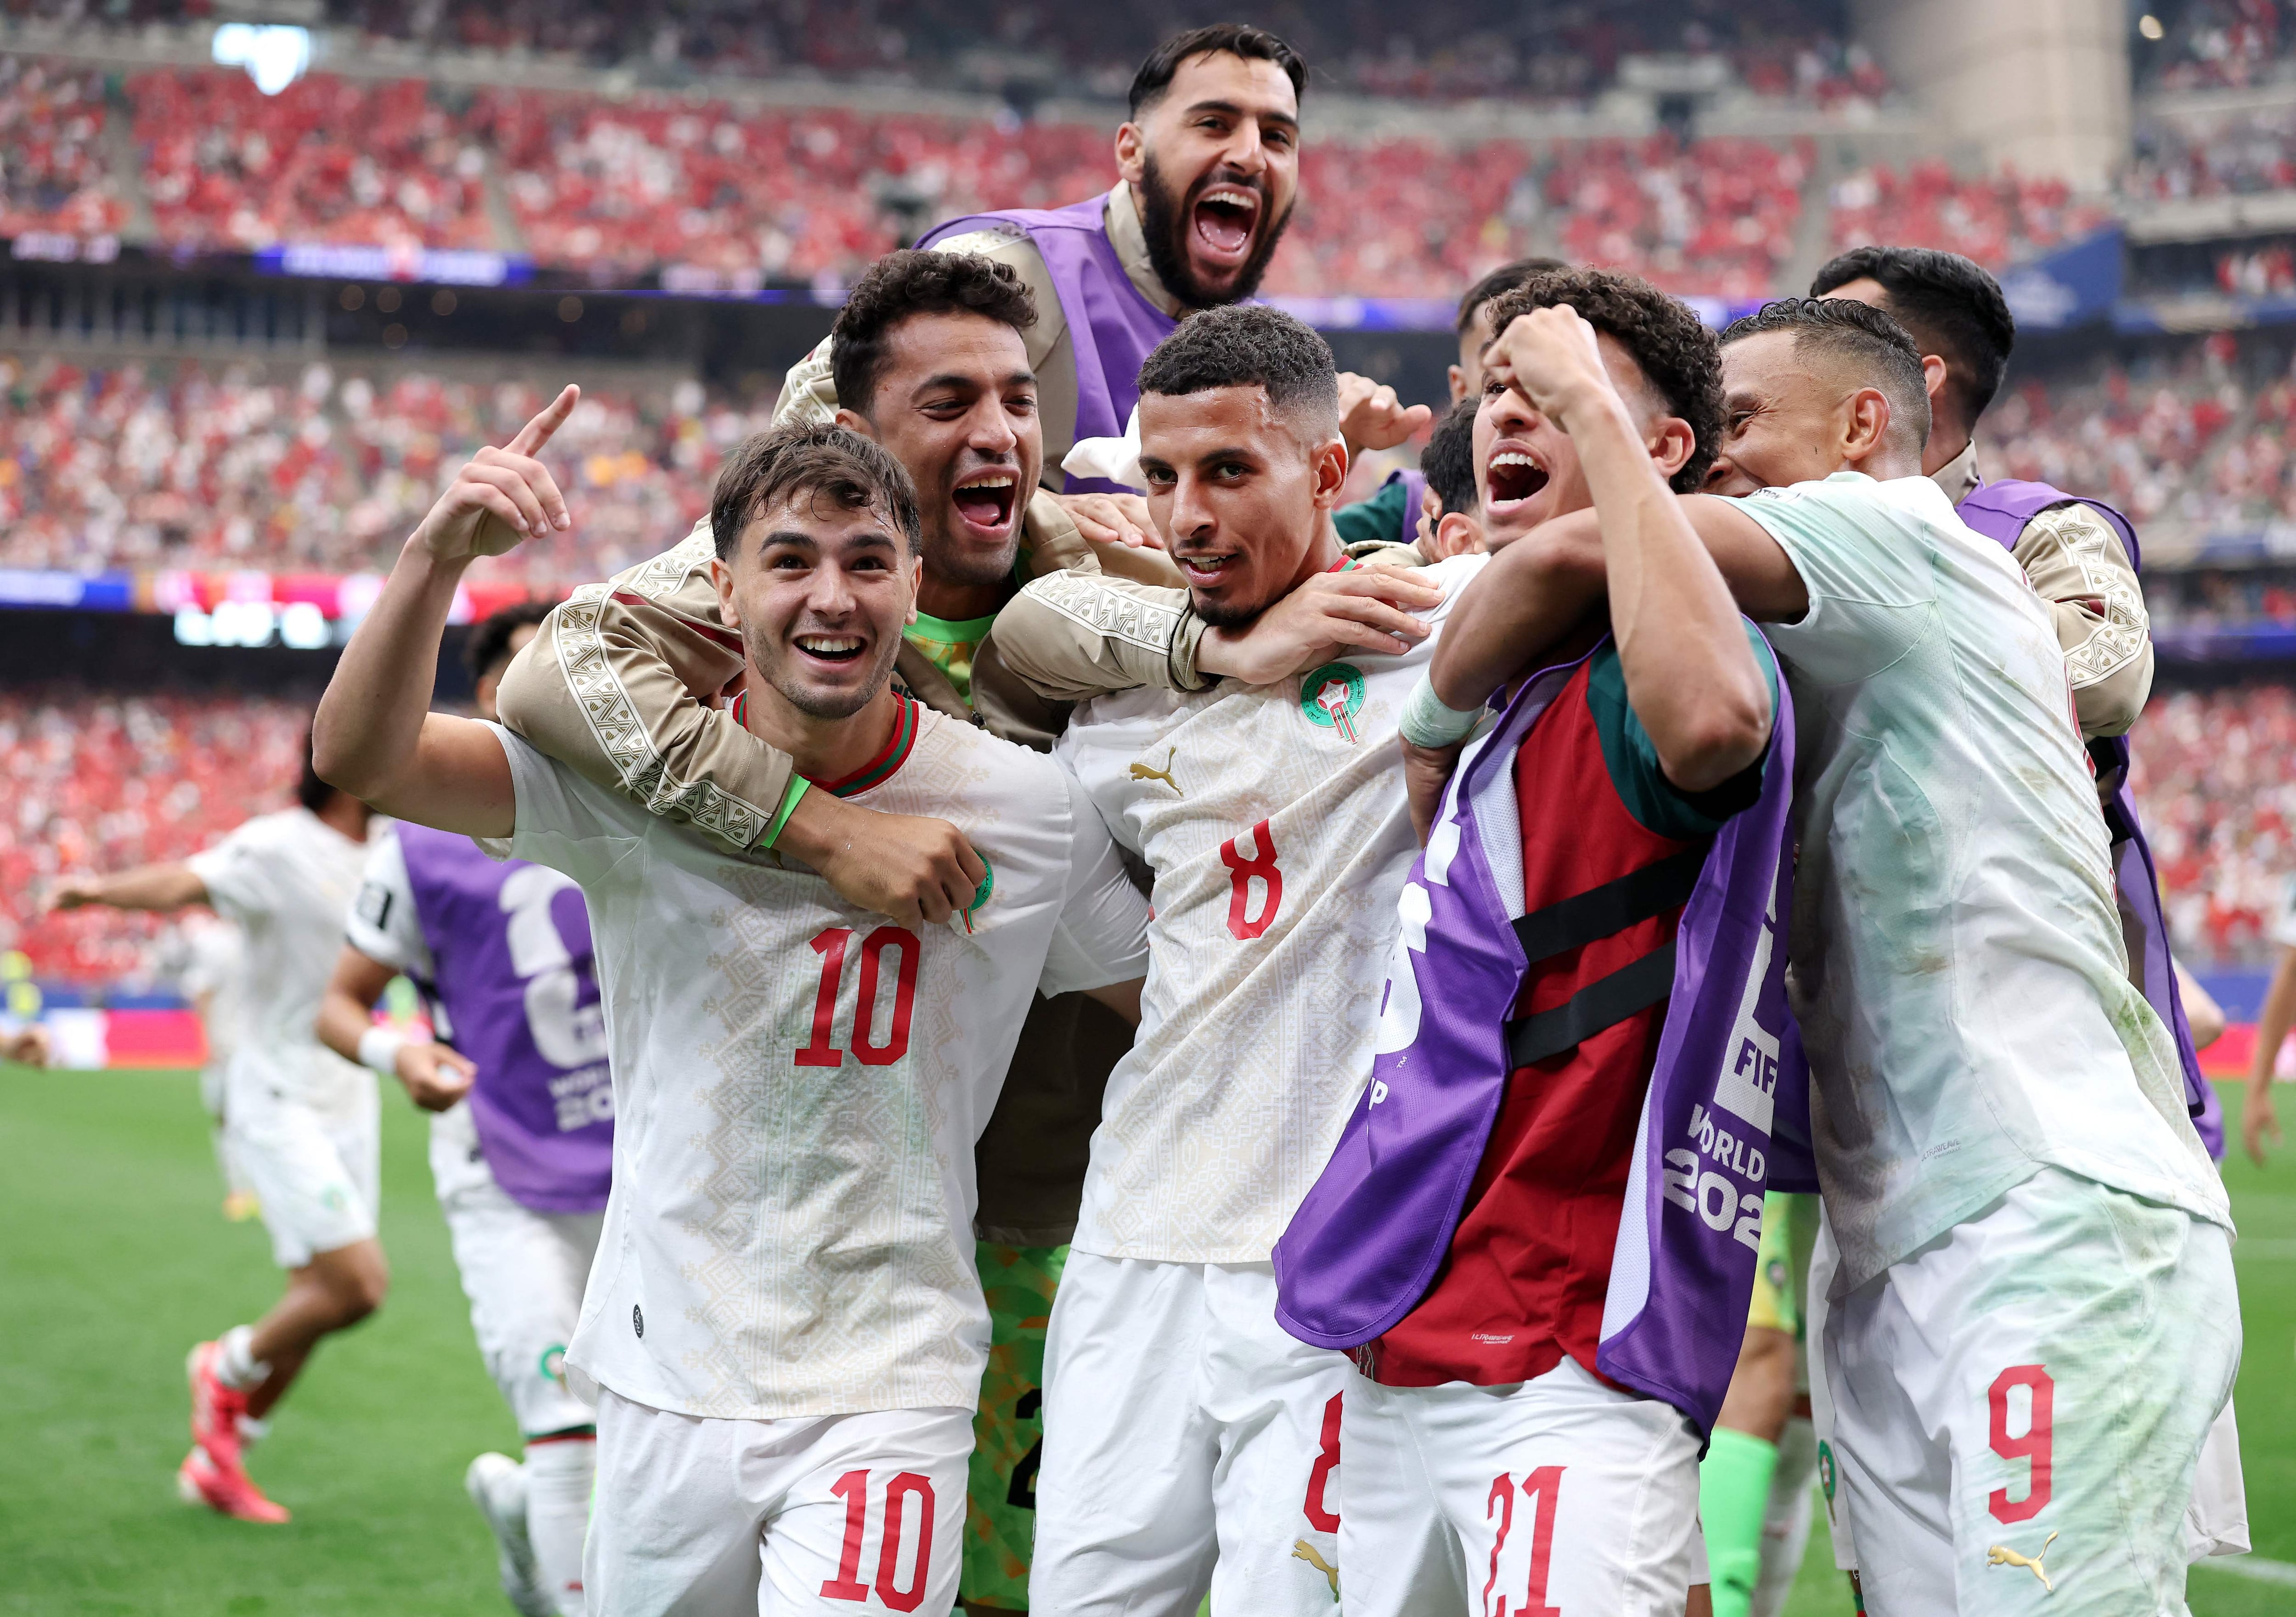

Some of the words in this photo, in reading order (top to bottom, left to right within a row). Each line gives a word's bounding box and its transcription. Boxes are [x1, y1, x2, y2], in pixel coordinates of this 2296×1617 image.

[1220, 818, 1283, 941] 8
[793, 926, 921, 1067] 10
[1734, 1037, 1778, 1093] FIF
[1663, 1148, 1764, 1254] 202
[1987, 1363, 2055, 1525] 9
[819, 1469, 935, 1613] 10
[1483, 1466, 1569, 1617] 21
